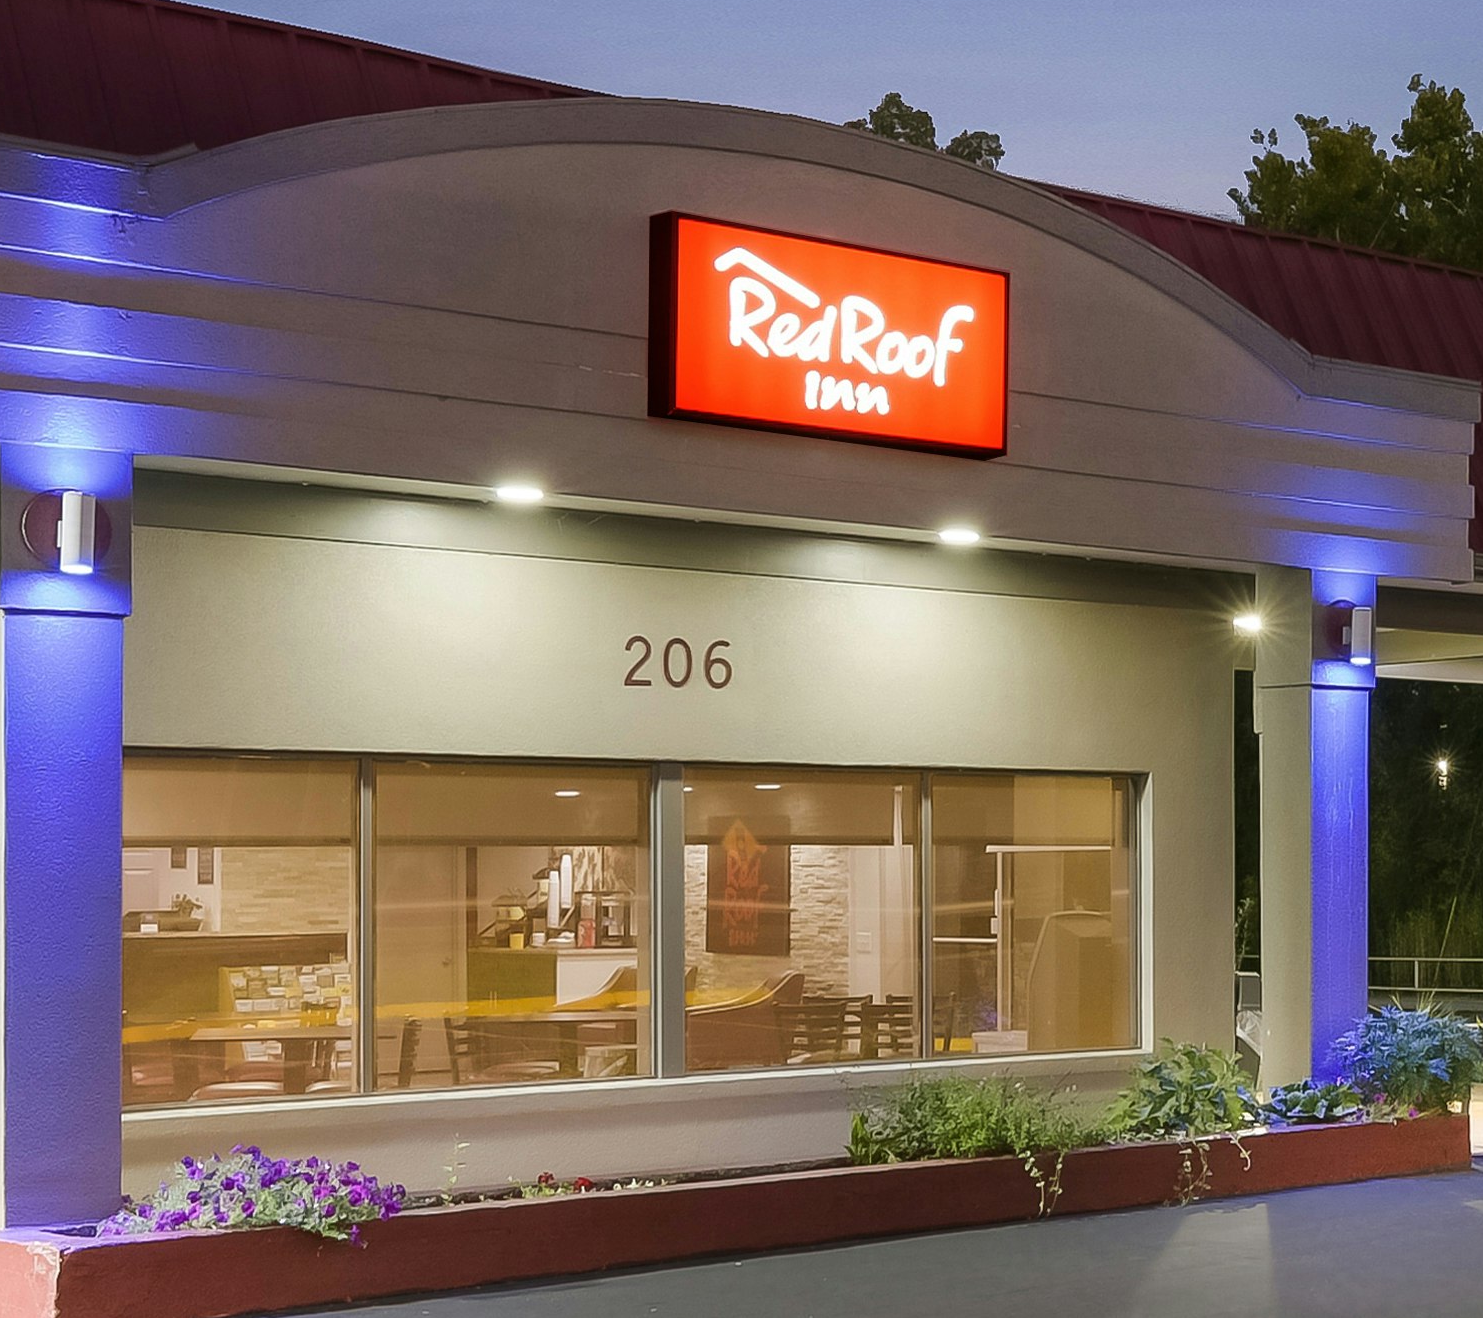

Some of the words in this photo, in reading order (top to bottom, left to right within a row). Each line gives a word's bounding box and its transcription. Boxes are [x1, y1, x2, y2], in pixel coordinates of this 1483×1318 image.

[729, 276, 838, 362] Red
[839, 295, 974, 386] Roof
[623, 635, 733, 690] 206
